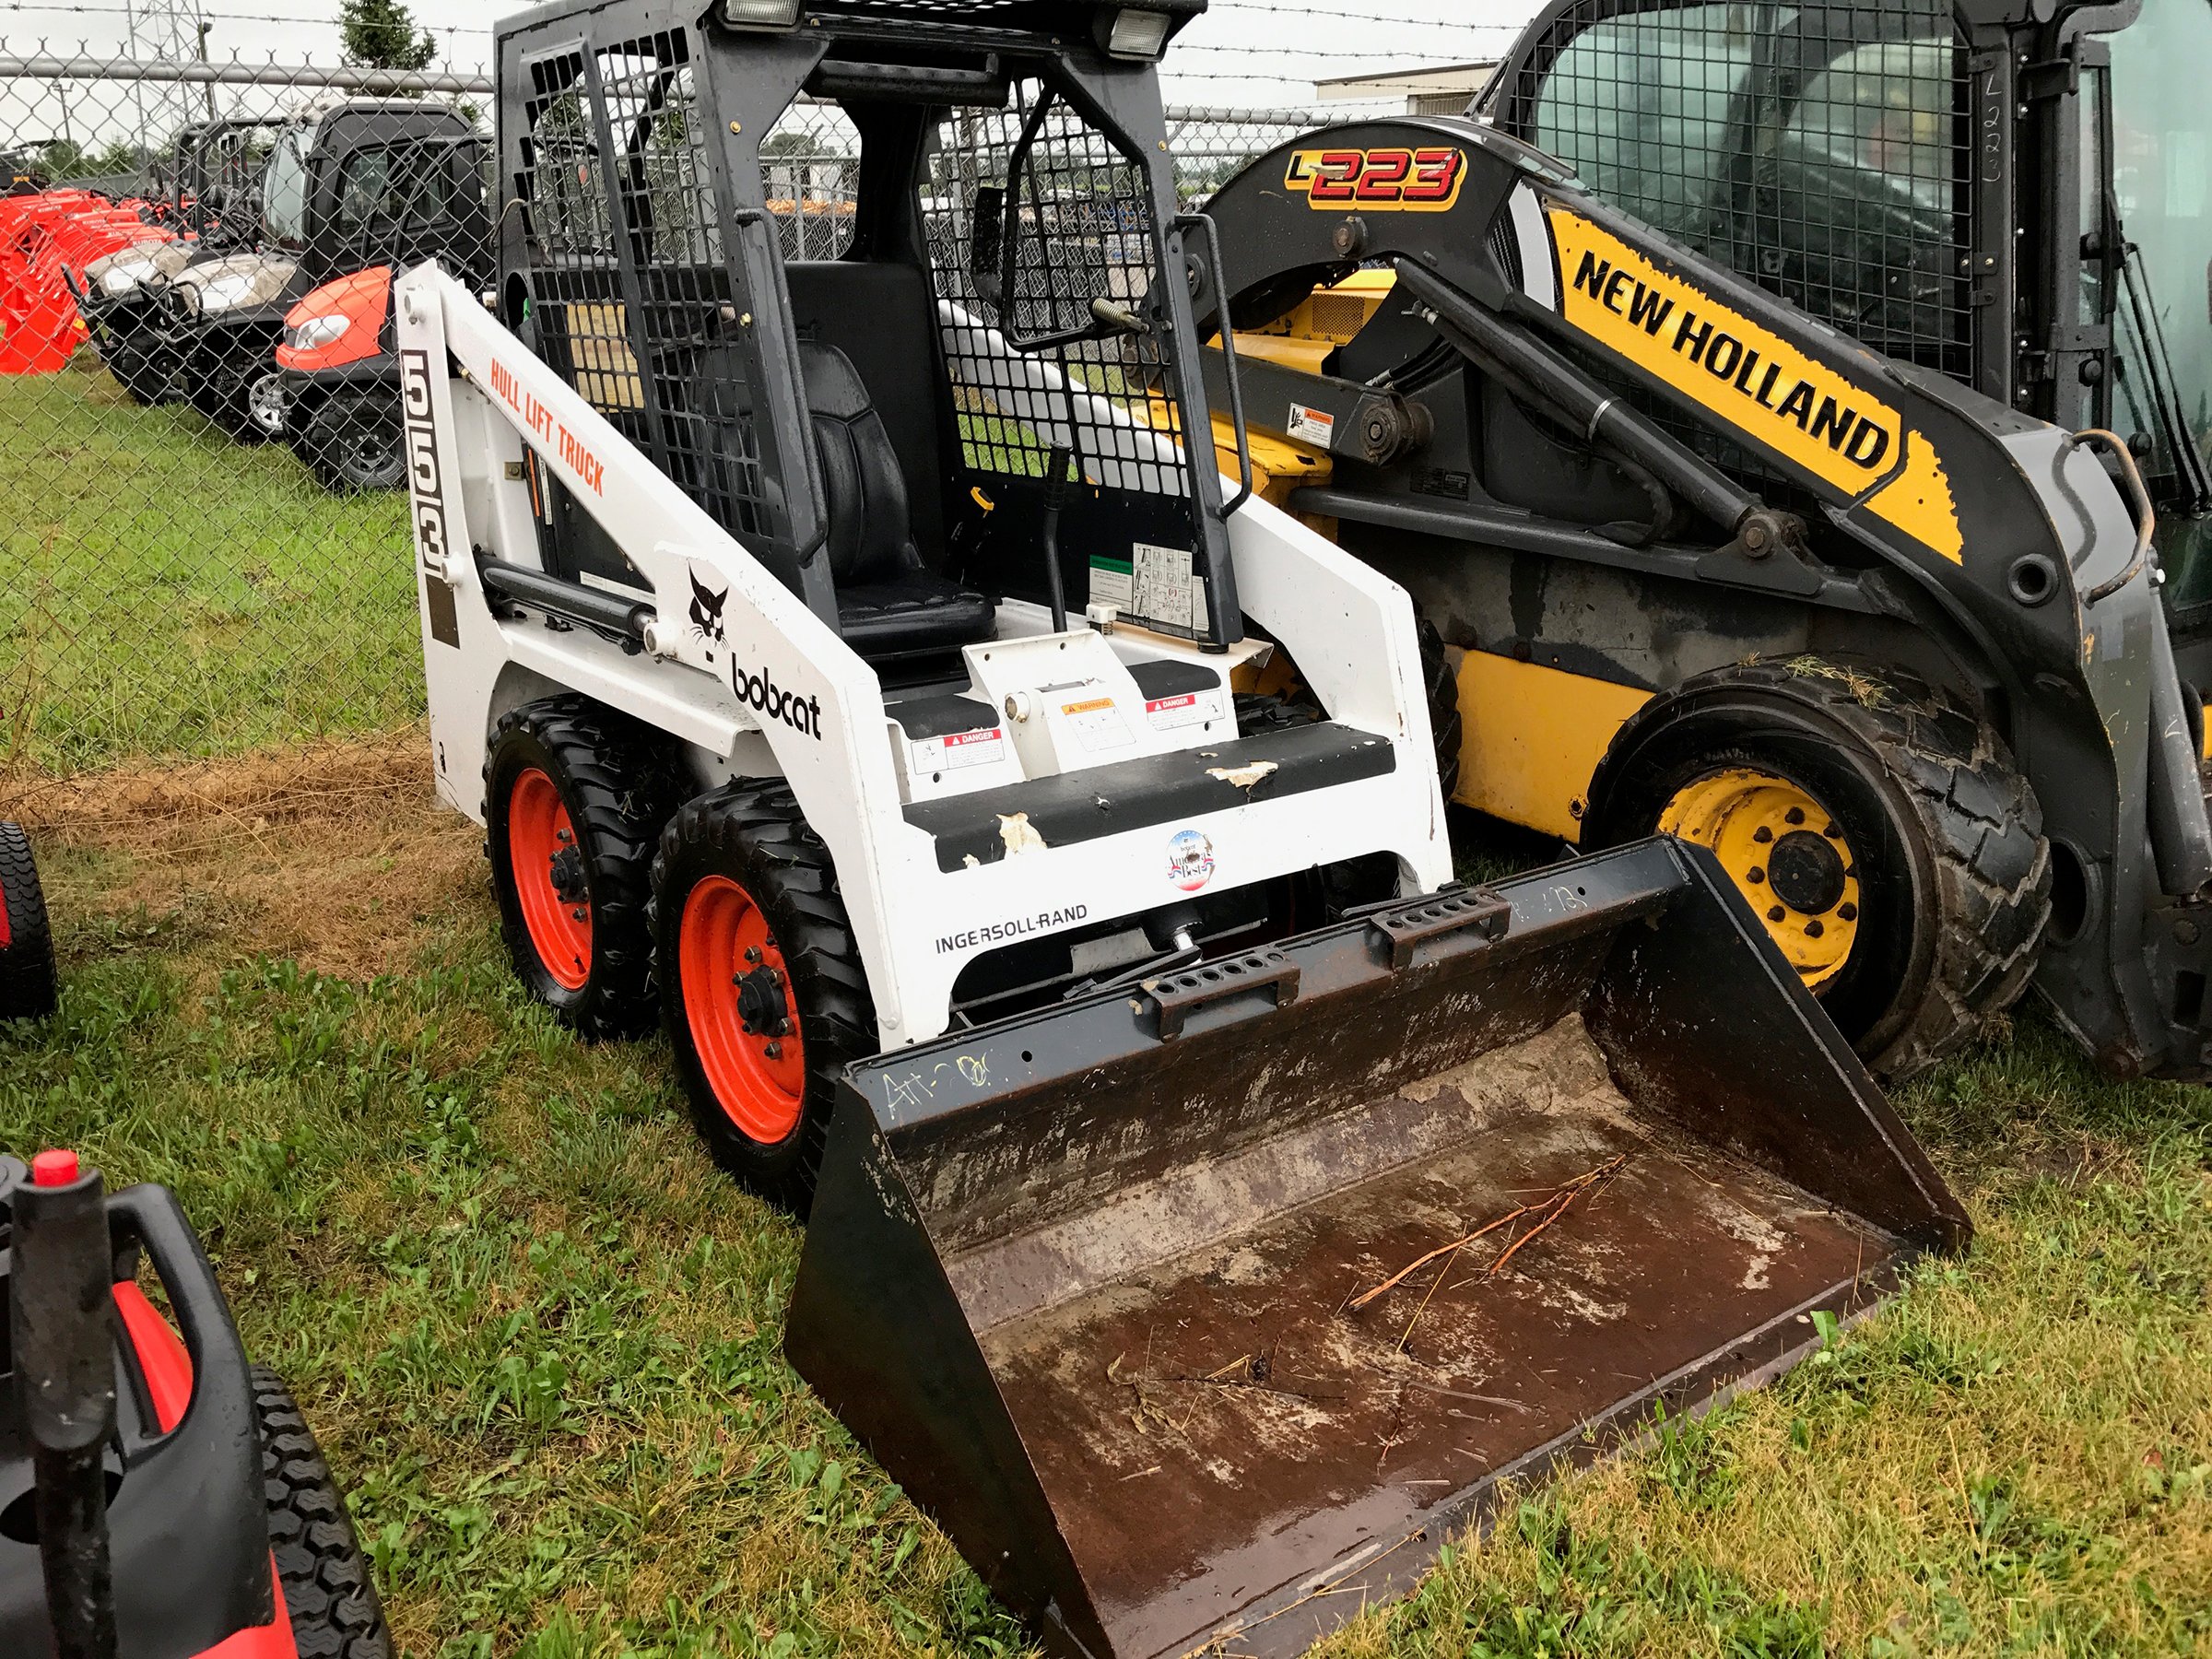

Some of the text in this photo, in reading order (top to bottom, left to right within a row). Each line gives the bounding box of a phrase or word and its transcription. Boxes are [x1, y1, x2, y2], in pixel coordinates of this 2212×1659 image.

[1572, 249, 1890, 470] NEW HOLLAND
[490, 357, 605, 498] HULL LIFT TRUCK
[732, 652, 821, 741] bobcat
[1077, 700, 1110, 711] WARNING
[1162, 698, 1189, 708] DANGER
[961, 731, 994, 744] DANGER
[935, 904, 1088, 954] INGERSOLL-RAND
